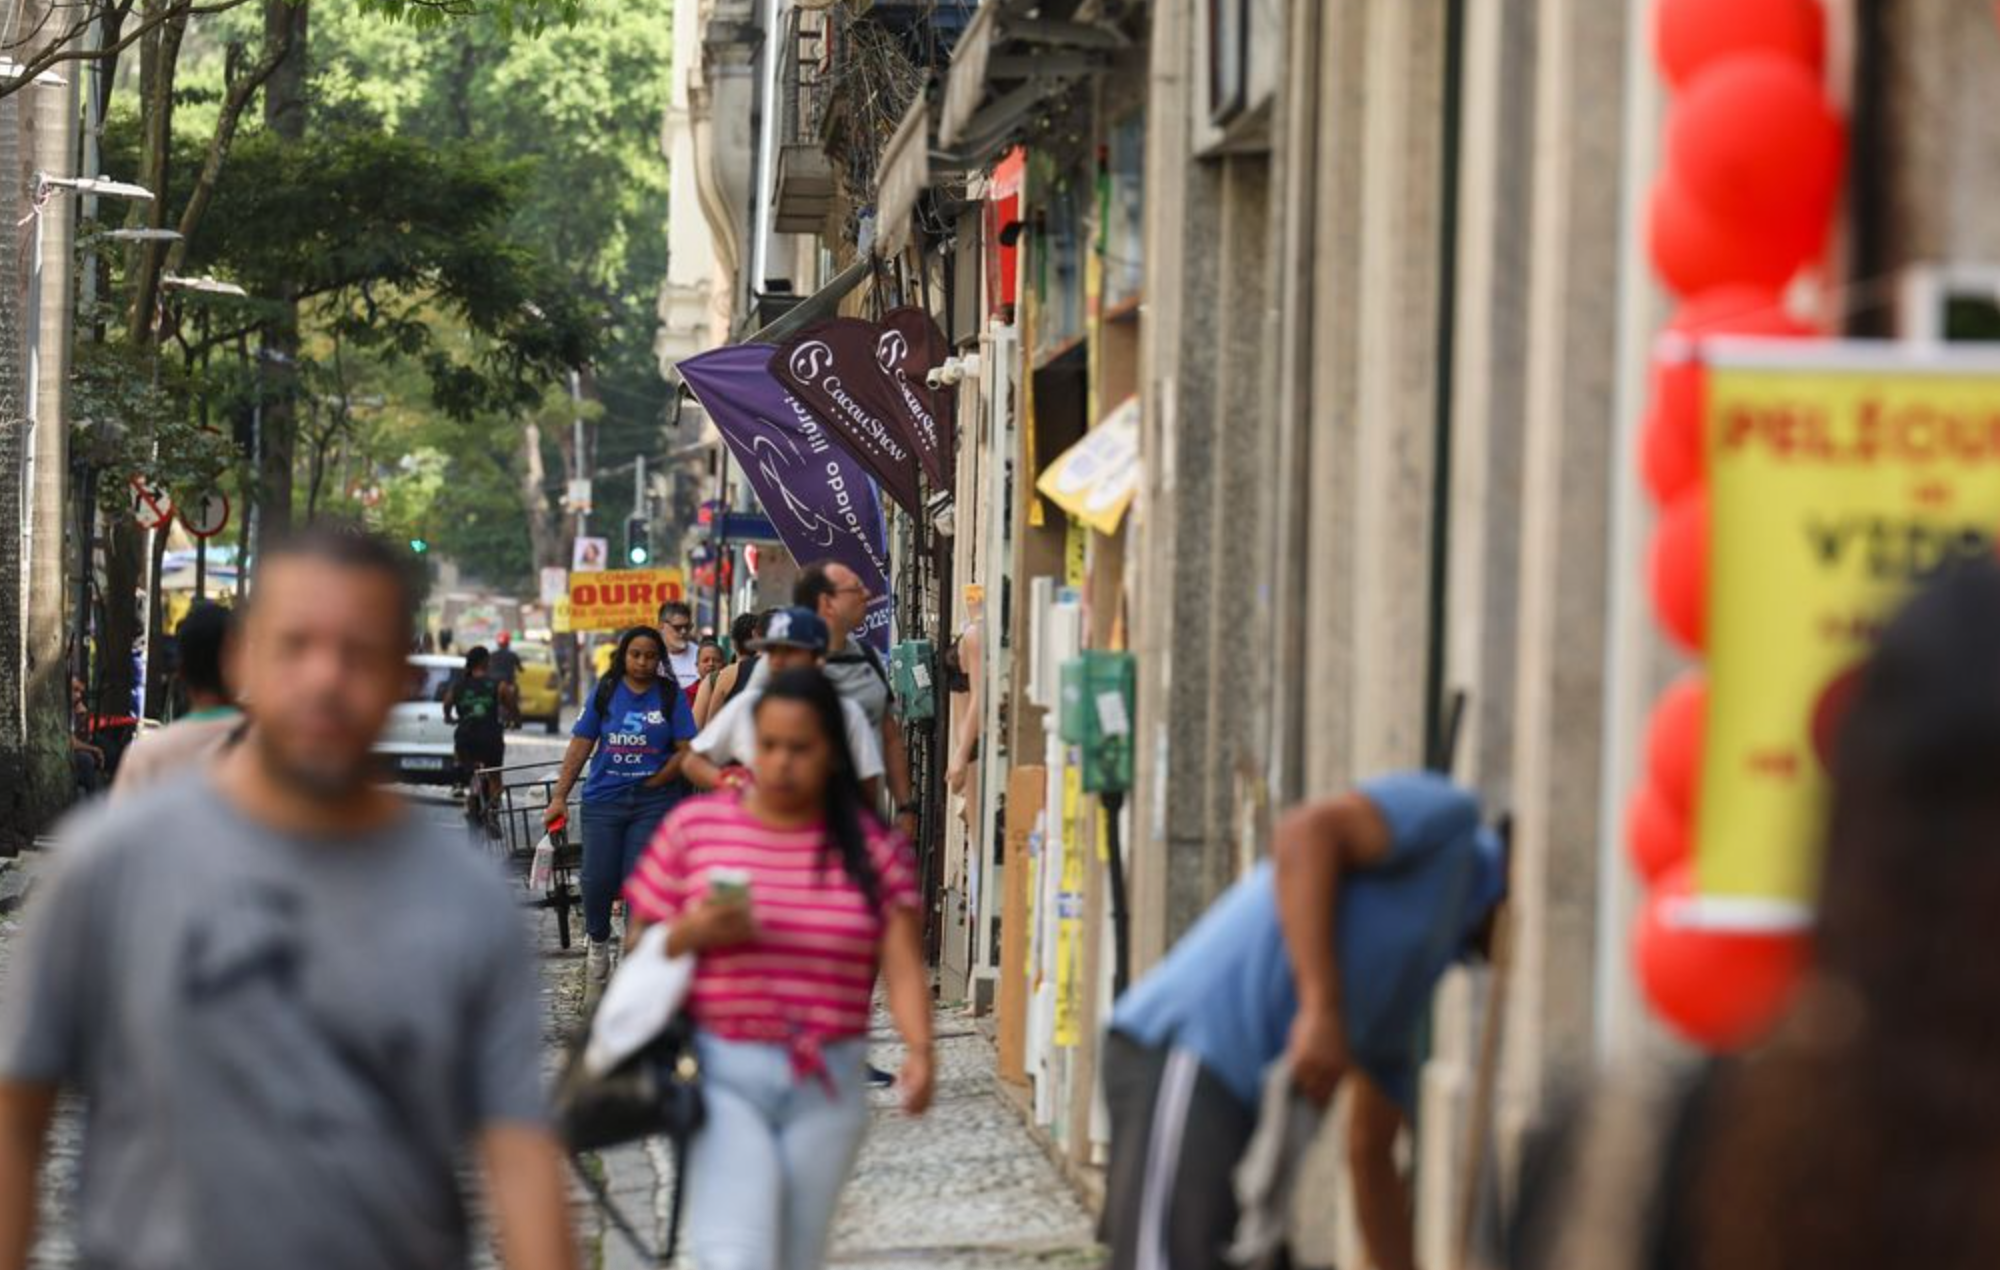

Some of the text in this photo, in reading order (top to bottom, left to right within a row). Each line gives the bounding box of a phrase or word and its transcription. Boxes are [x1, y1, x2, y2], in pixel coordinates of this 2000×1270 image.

[1720, 396, 2000, 465] PELÍCU
[572, 583, 680, 605] OURO
[608, 732, 647, 746] anos
